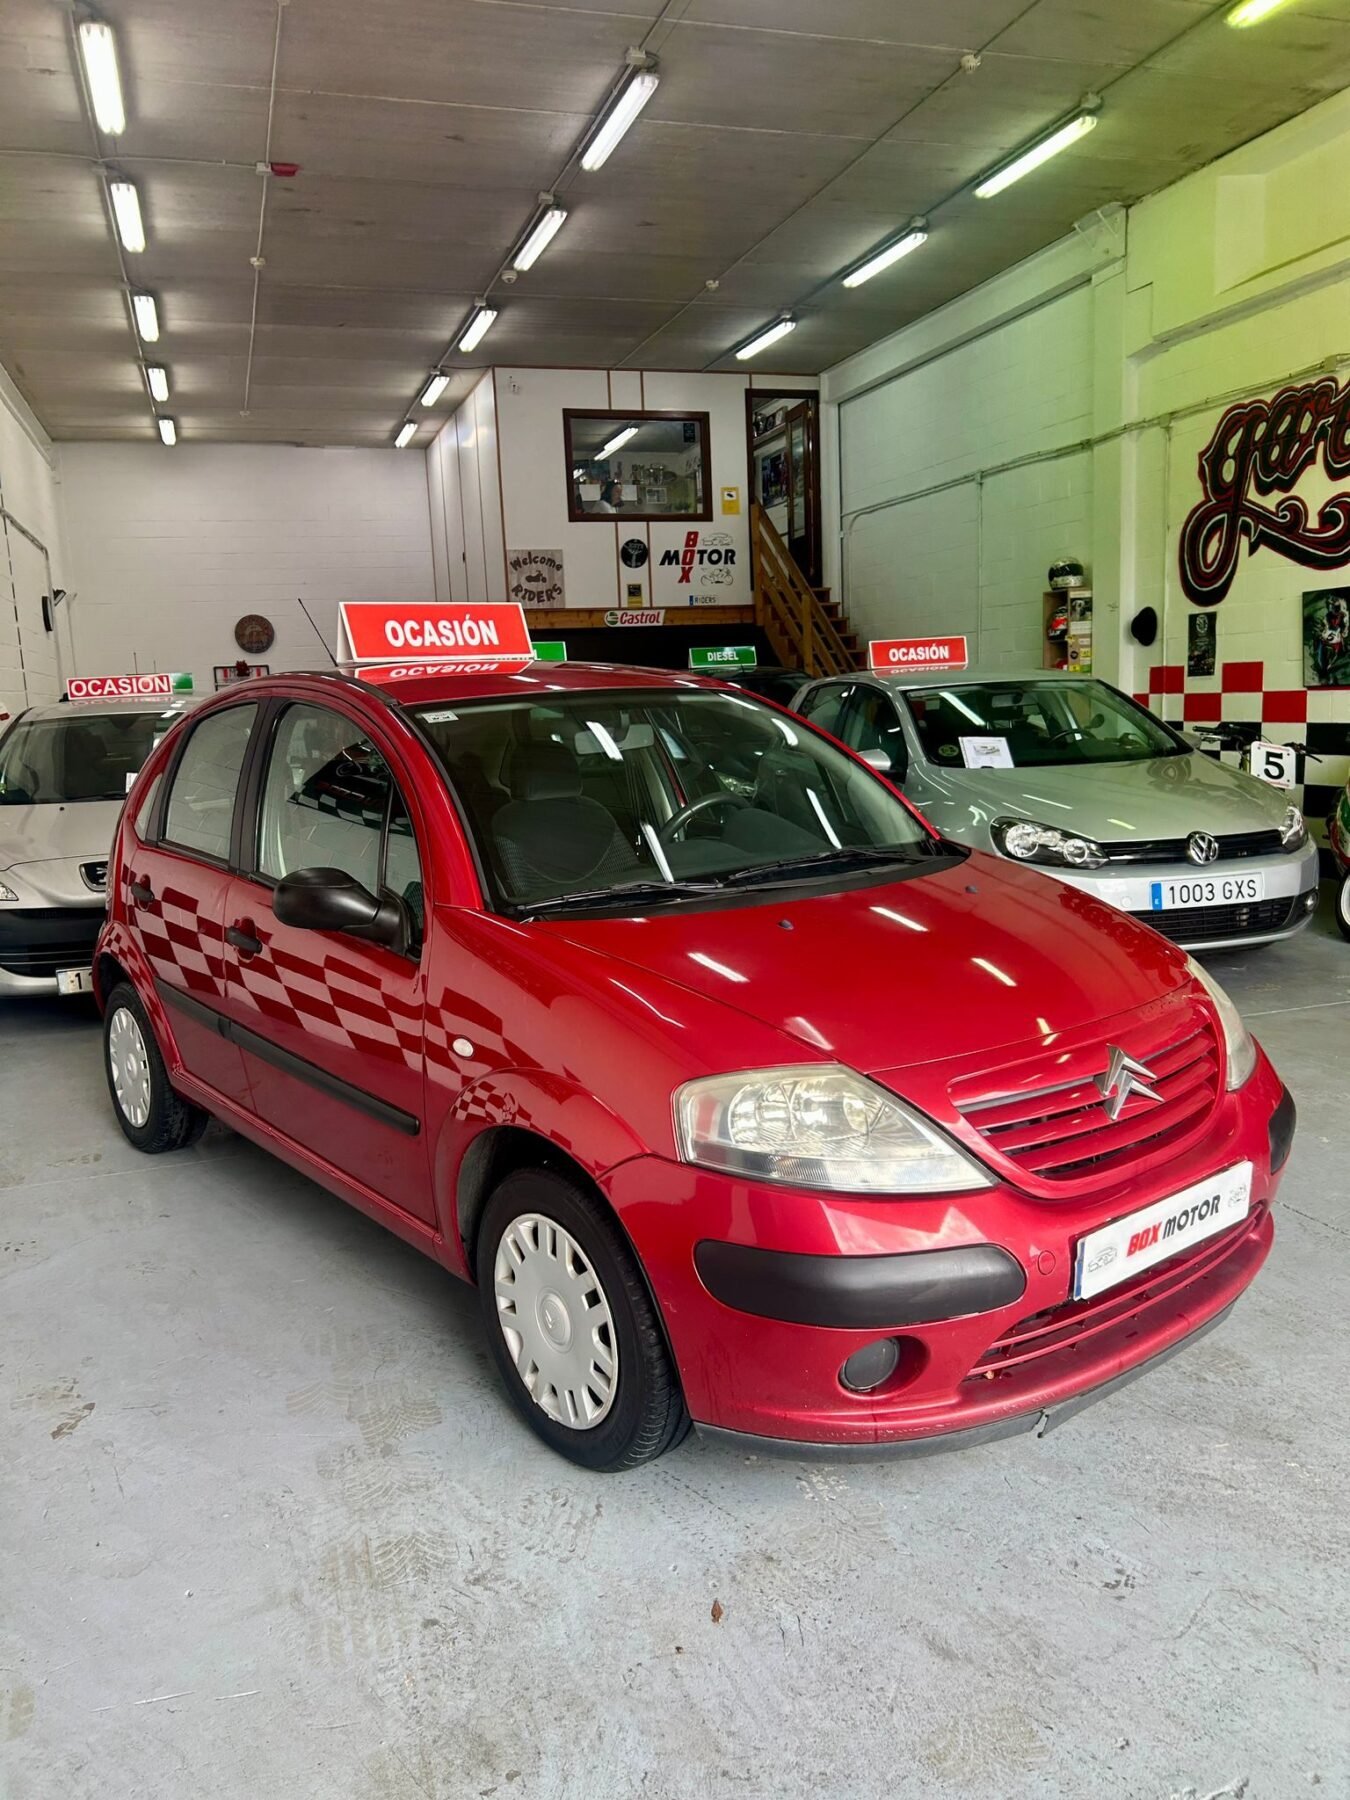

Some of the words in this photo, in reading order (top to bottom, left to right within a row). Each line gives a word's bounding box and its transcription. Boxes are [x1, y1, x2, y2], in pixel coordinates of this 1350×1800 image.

[510, 551, 563, 571] Welcome
[659, 549, 736, 566] MOTOR
[511, 583, 562, 603] RIDERS
[620, 612, 660, 625] Castrol
[384, 614, 499, 647] OCASIÓN
[707, 651, 739, 661] DIESEL
[889, 643, 949, 662] OCASIÓN
[70, 677, 168, 696] OCASION
[1263, 751, 1285, 779] 5
[1169, 883, 1215, 905] 1003
[1222, 879, 1257, 900] GXS
[1126, 1221, 1162, 1257] BOX
[1162, 1194, 1221, 1240] MOTOR
